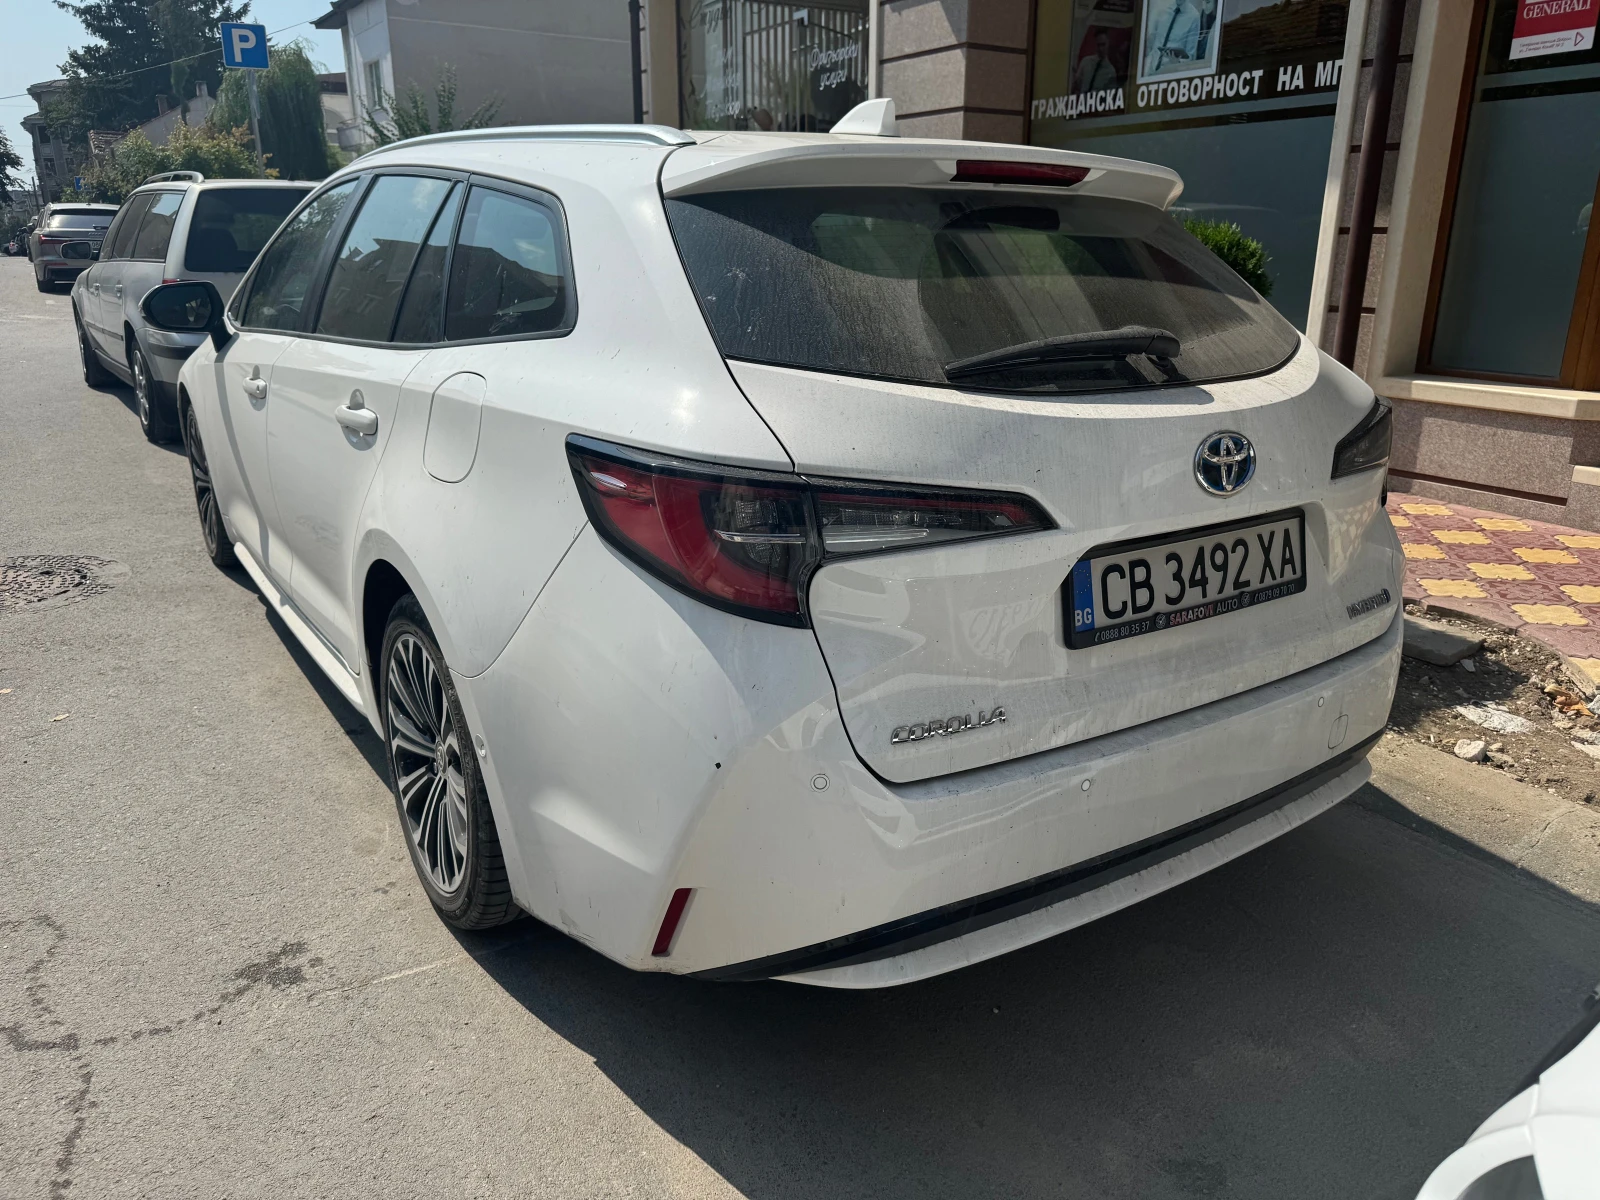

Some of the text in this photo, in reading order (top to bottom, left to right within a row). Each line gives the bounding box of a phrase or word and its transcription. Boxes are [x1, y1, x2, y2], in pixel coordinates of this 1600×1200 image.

[1523, 0, 1591, 19] GENERALI
[231, 28, 257, 62] P
[1030, 87, 1124, 120] ГРАЖДАНСКА
[1137, 69, 1264, 107] ОТГОВОРНОСТ
[1277, 64, 1304, 91] НА
[1164, 538, 1250, 606] 3492
[1273, 587, 1280, 597] 09
[1288, 583, 1295, 593] 70
[1216, 598, 1238, 613] AUTO
[1074, 607, 1092, 627] BG
[1101, 620, 1150, 641] 0888 80 35 37
[891, 706, 1007, 745] COROLLA
